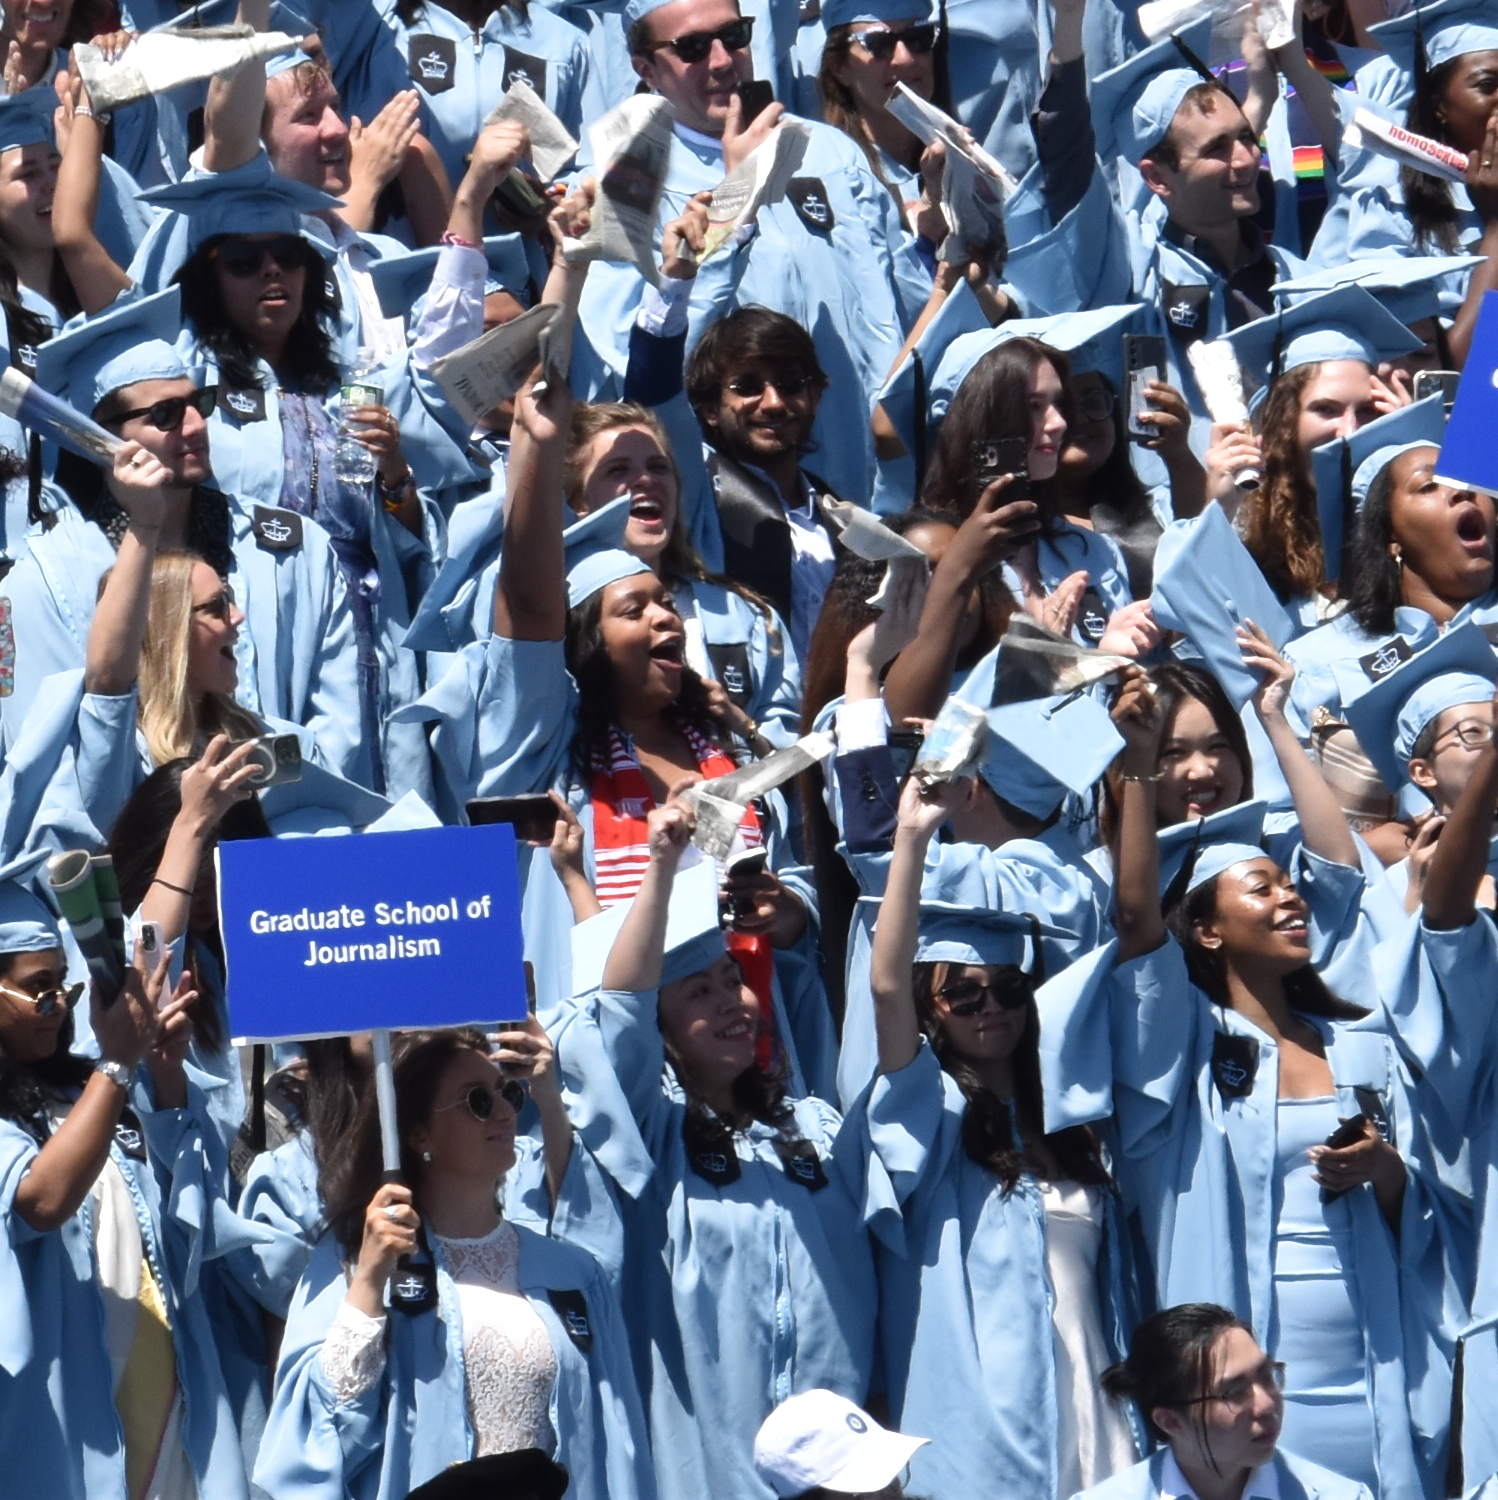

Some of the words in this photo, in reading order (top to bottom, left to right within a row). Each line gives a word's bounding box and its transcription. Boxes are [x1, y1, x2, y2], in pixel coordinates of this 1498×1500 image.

[1389, 125, 1468, 173] homosexua
[250, 905, 366, 934] Graduate
[375, 898, 459, 925] School
[466, 894, 492, 919] of
[303, 935, 441, 967] Journalism
